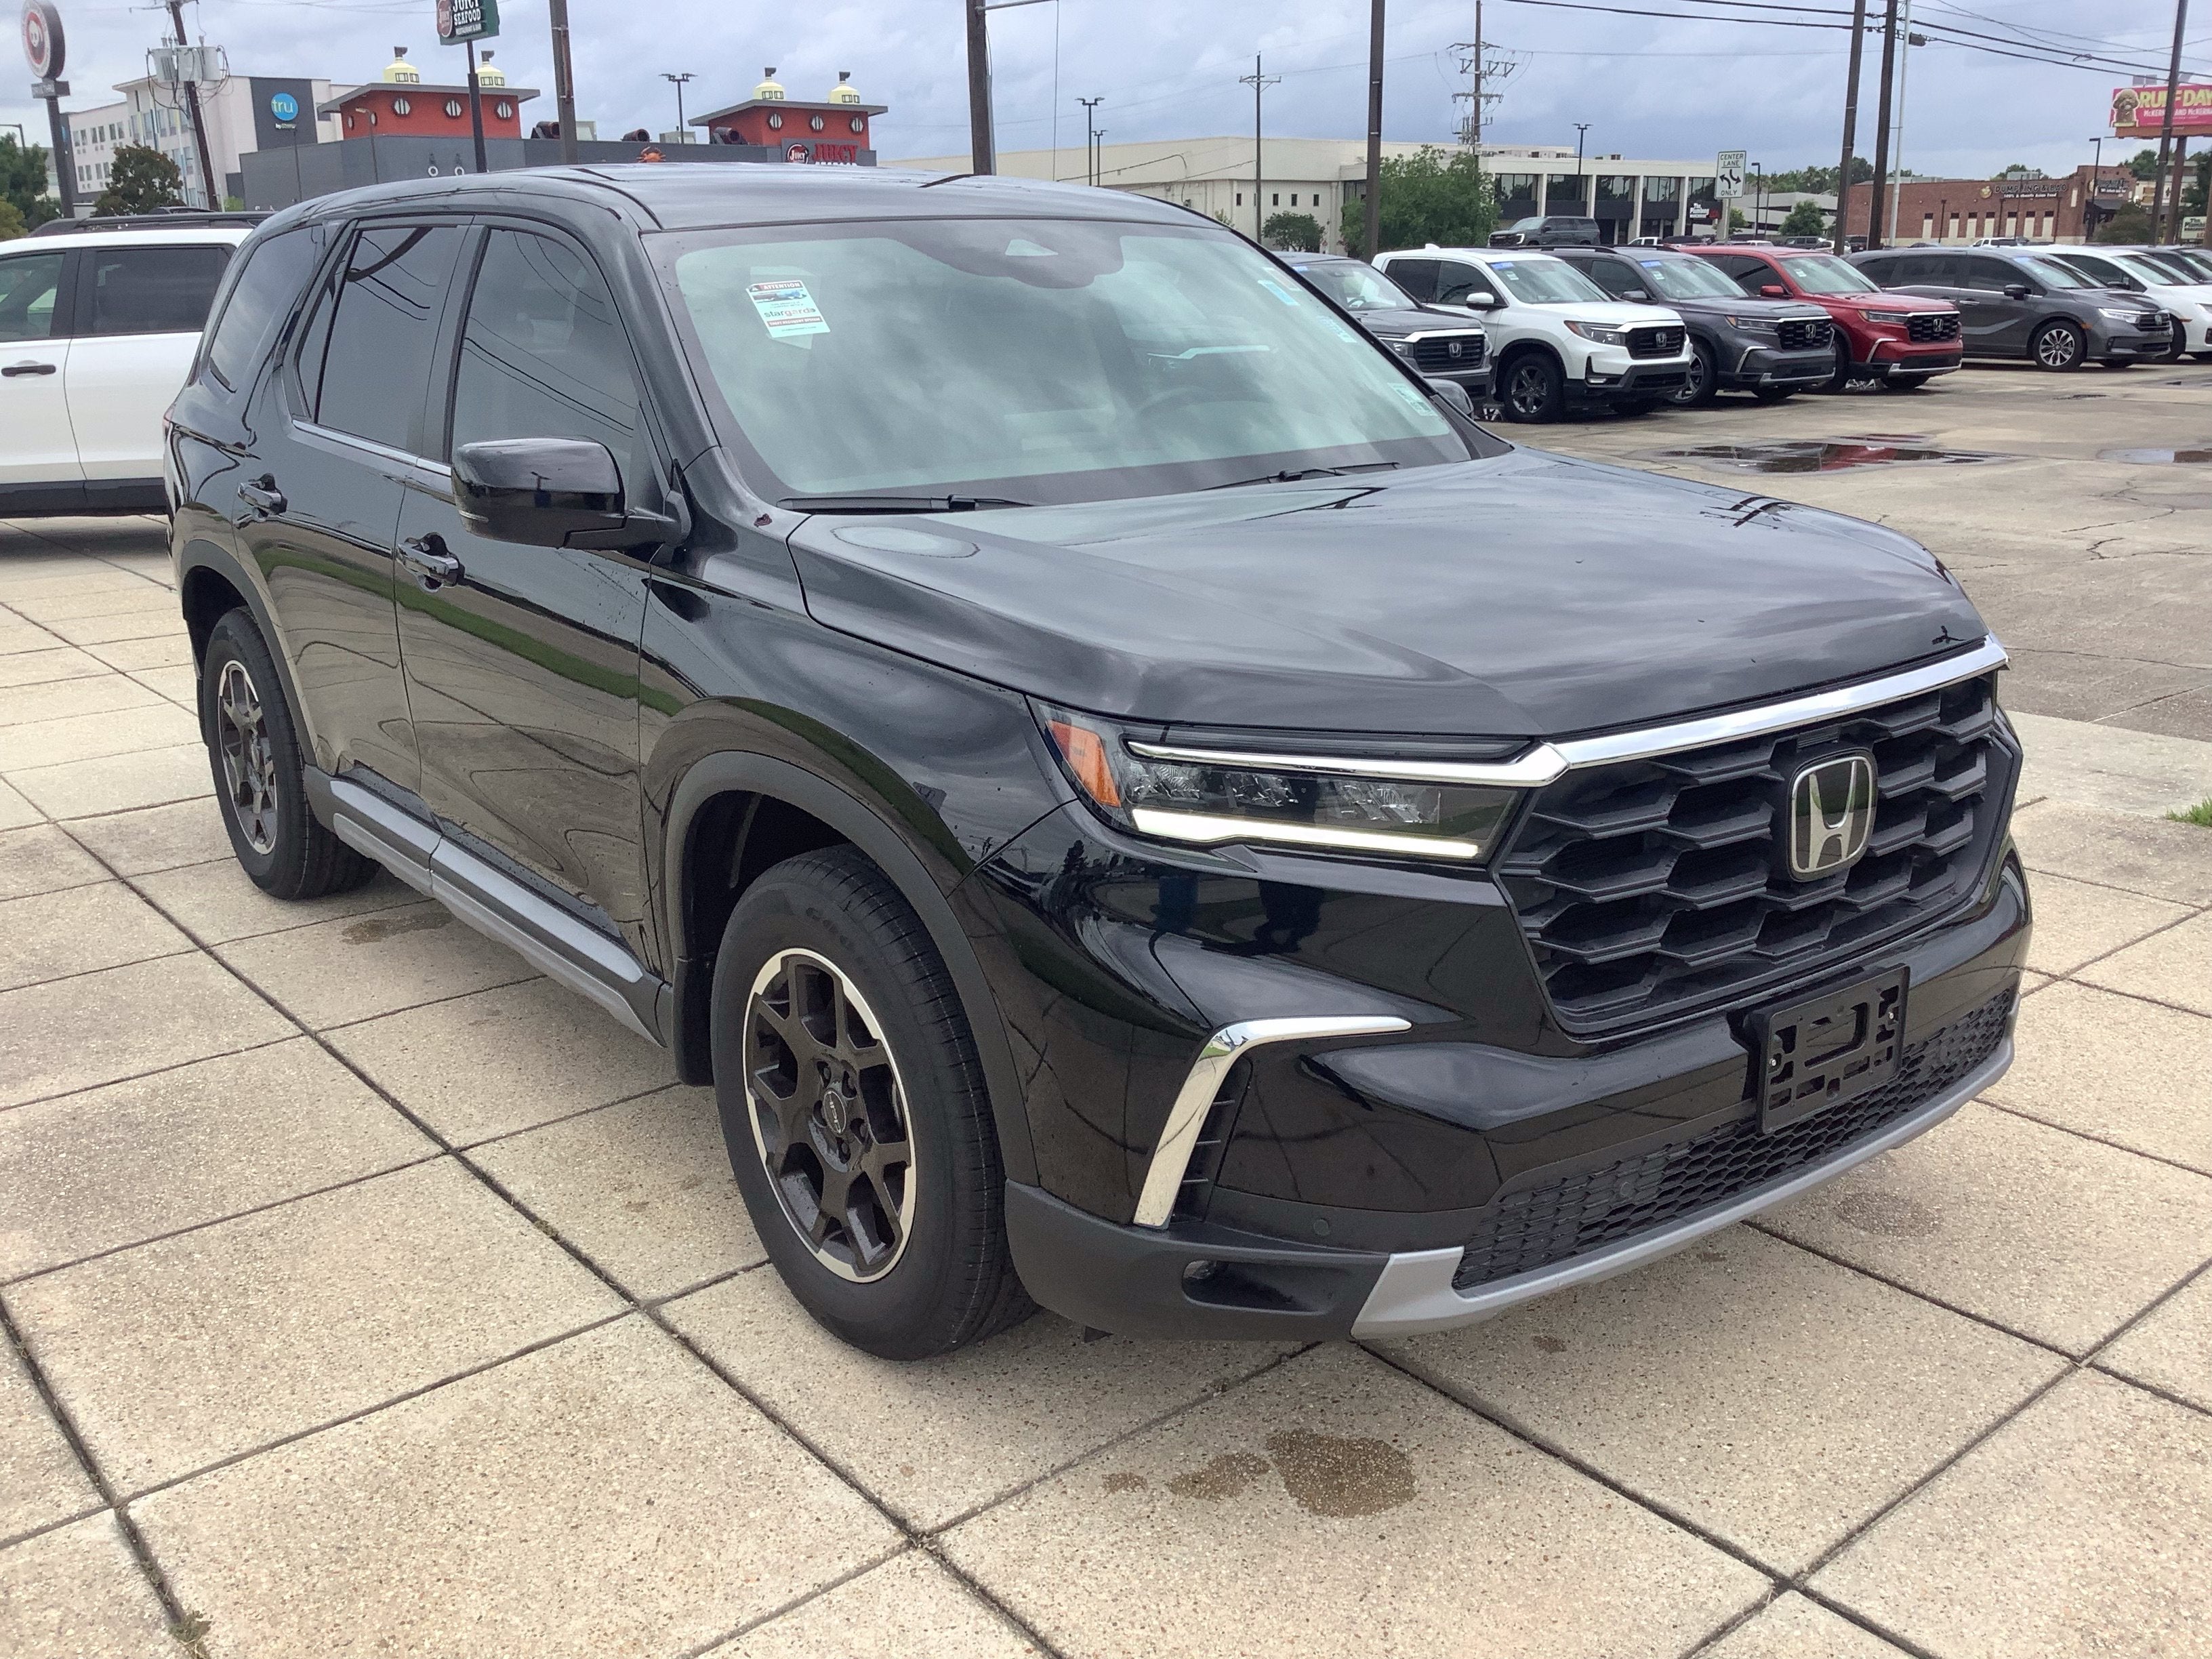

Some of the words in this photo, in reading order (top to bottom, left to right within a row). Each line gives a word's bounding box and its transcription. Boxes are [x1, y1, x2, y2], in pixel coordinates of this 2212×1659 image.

[454, 8, 481, 26] SEAFOOD
[271, 100, 293, 113] tru
[814, 144, 857, 162] JUICY
[1994, 184, 2039, 194] DUMPING
[764, 282, 800, 290] ATTENTION
